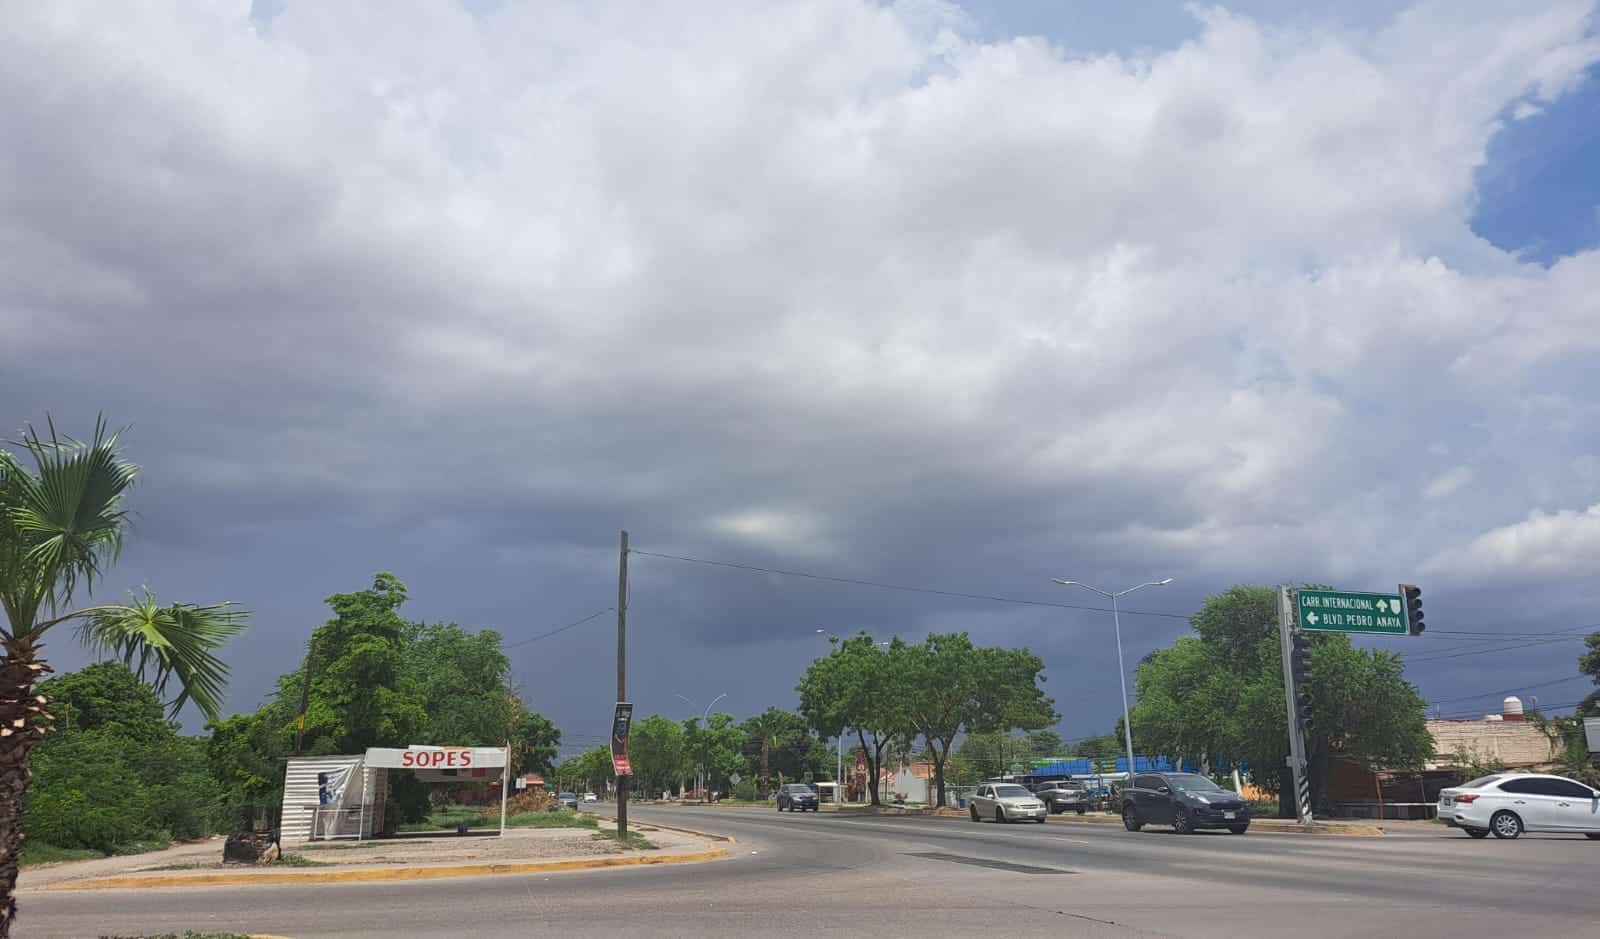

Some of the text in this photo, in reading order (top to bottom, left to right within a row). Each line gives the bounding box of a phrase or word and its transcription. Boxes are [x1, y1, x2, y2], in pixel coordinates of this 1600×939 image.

[1302, 596, 1374, 610] CARR. INTERNACIONAL
[1323, 614, 1401, 628] BLVD. PEDRO ANAYA
[402, 751, 471, 767] SOPES
